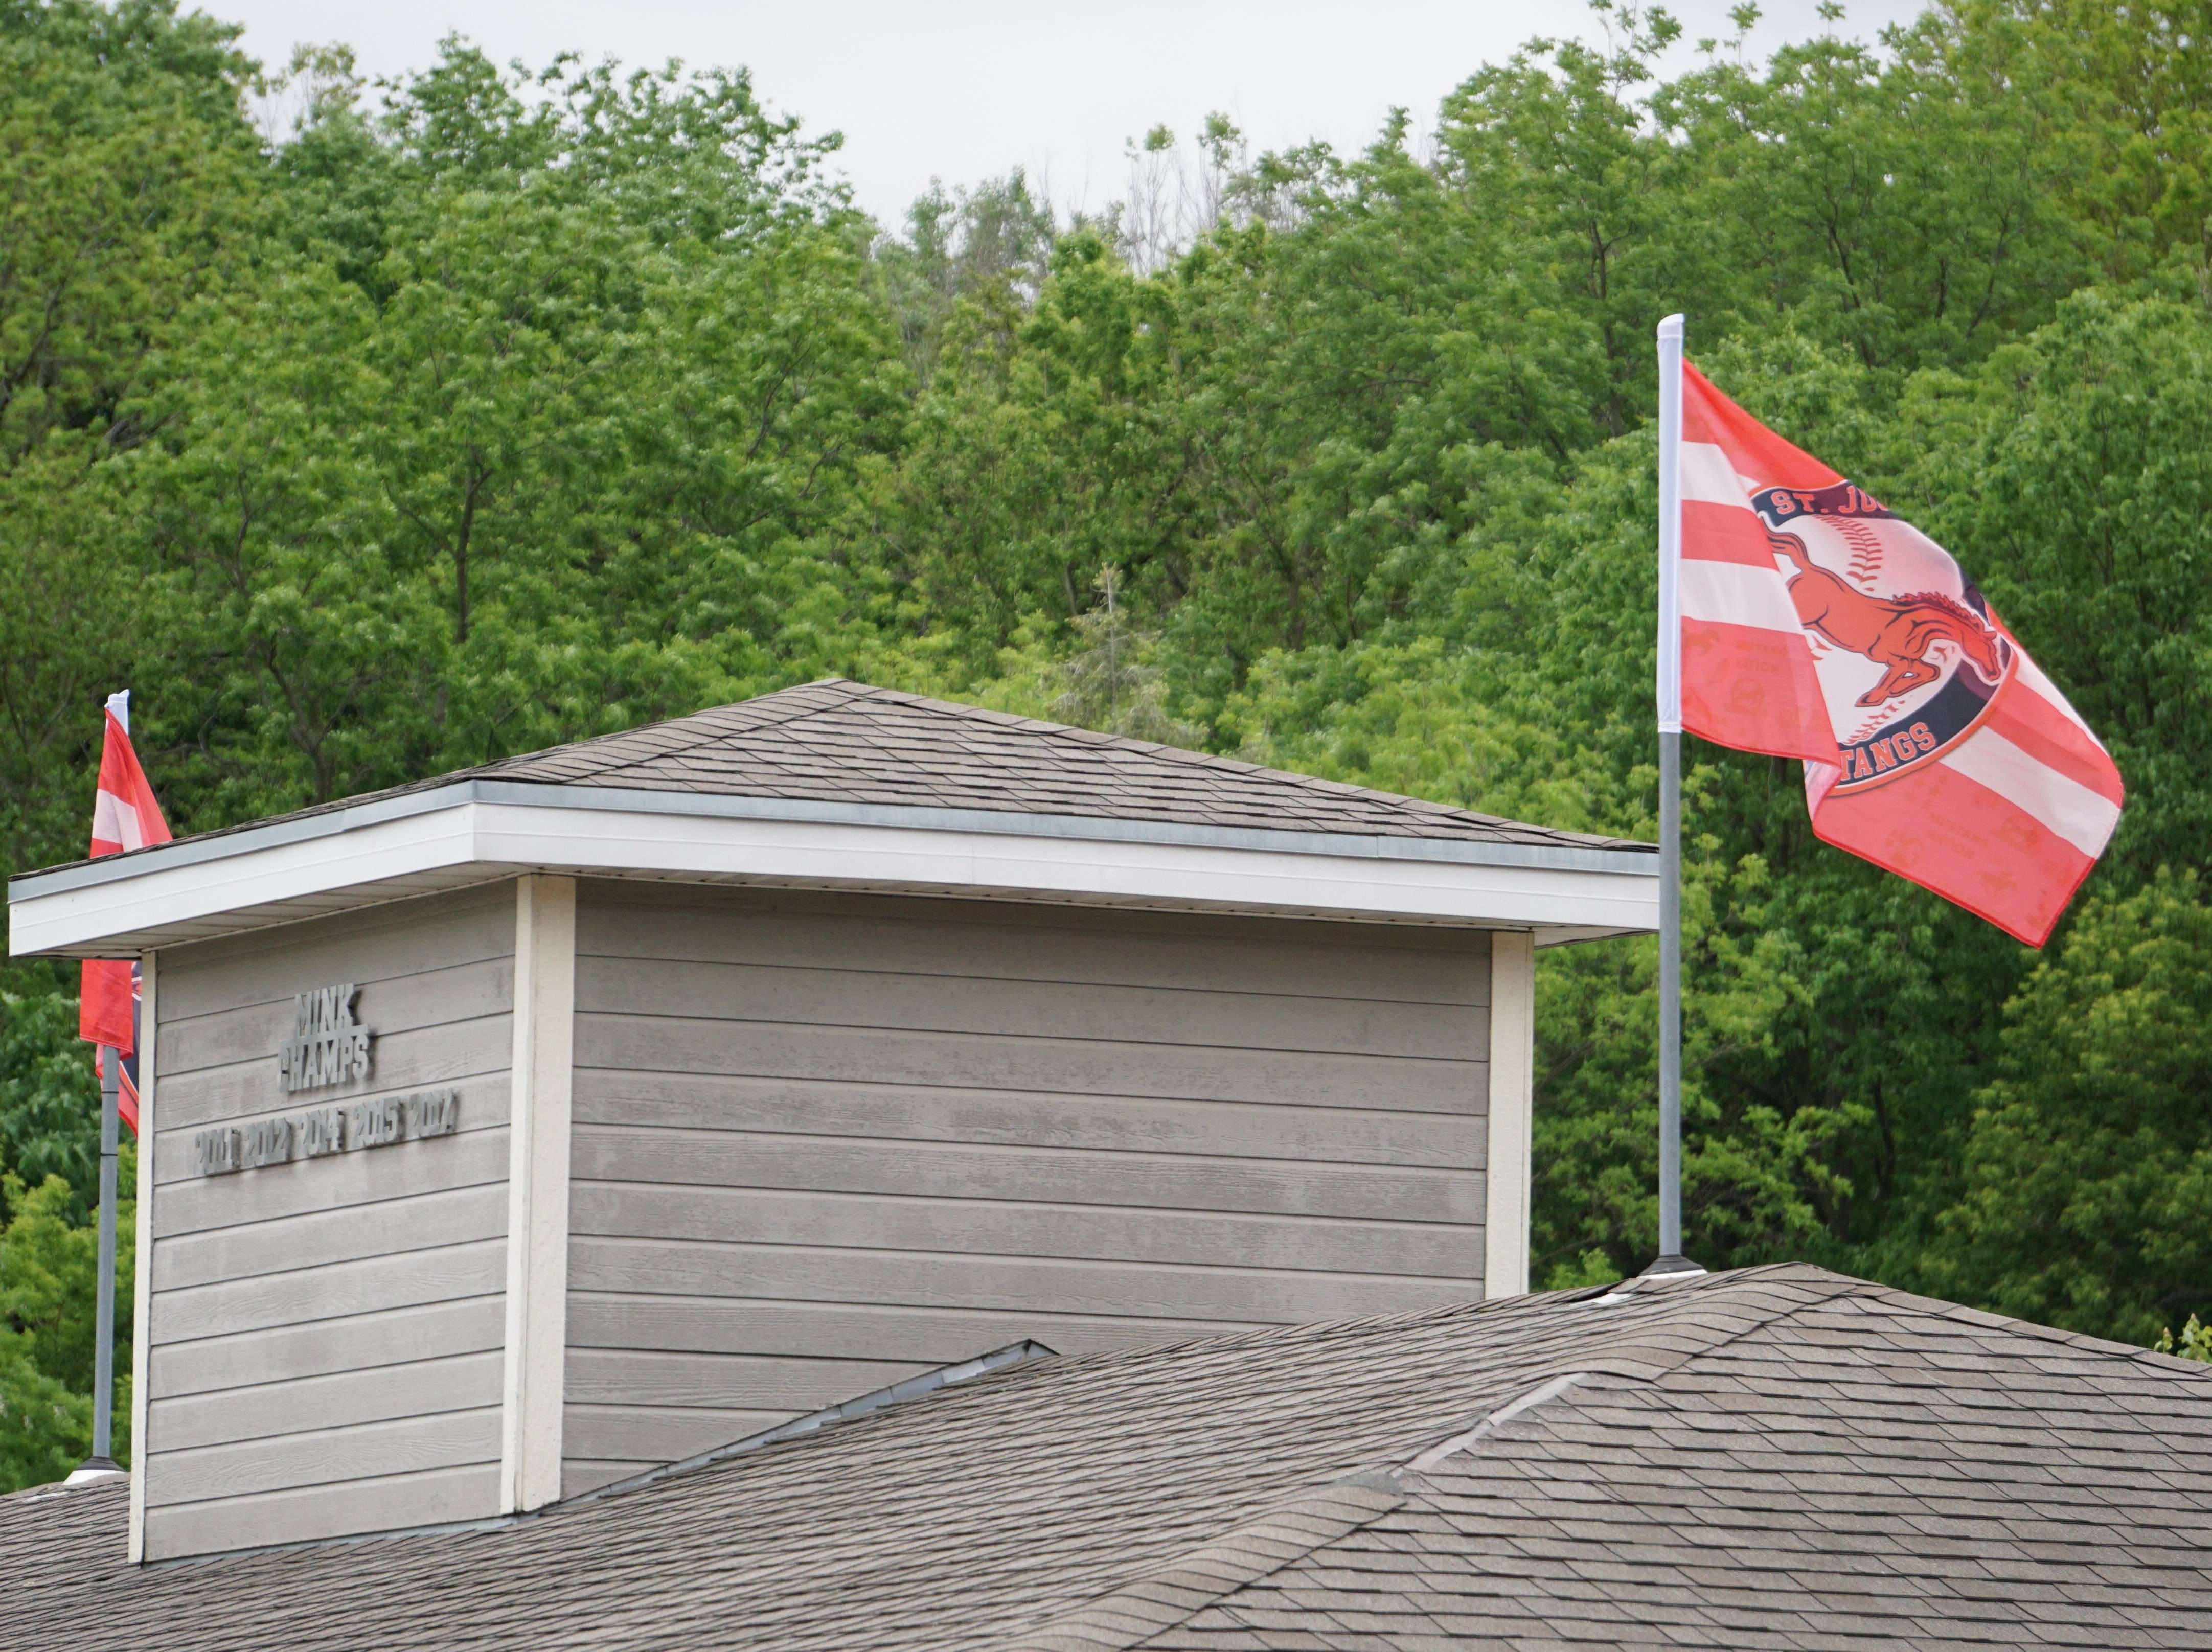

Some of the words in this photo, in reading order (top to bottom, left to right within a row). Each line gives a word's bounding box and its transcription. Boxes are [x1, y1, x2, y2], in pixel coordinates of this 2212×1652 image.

[1770, 490, 1829, 515] ST.
[294, 983, 354, 1039] MINK
[278, 1023, 369, 1093] CHAMPS
[194, 1127, 233, 1176] 2011
[243, 1117, 287, 1168] 2012
[294, 1108, 340, 1157] 2014
[351, 1095, 398, 1150] 2015
[407, 1087, 453, 1141] 2017
